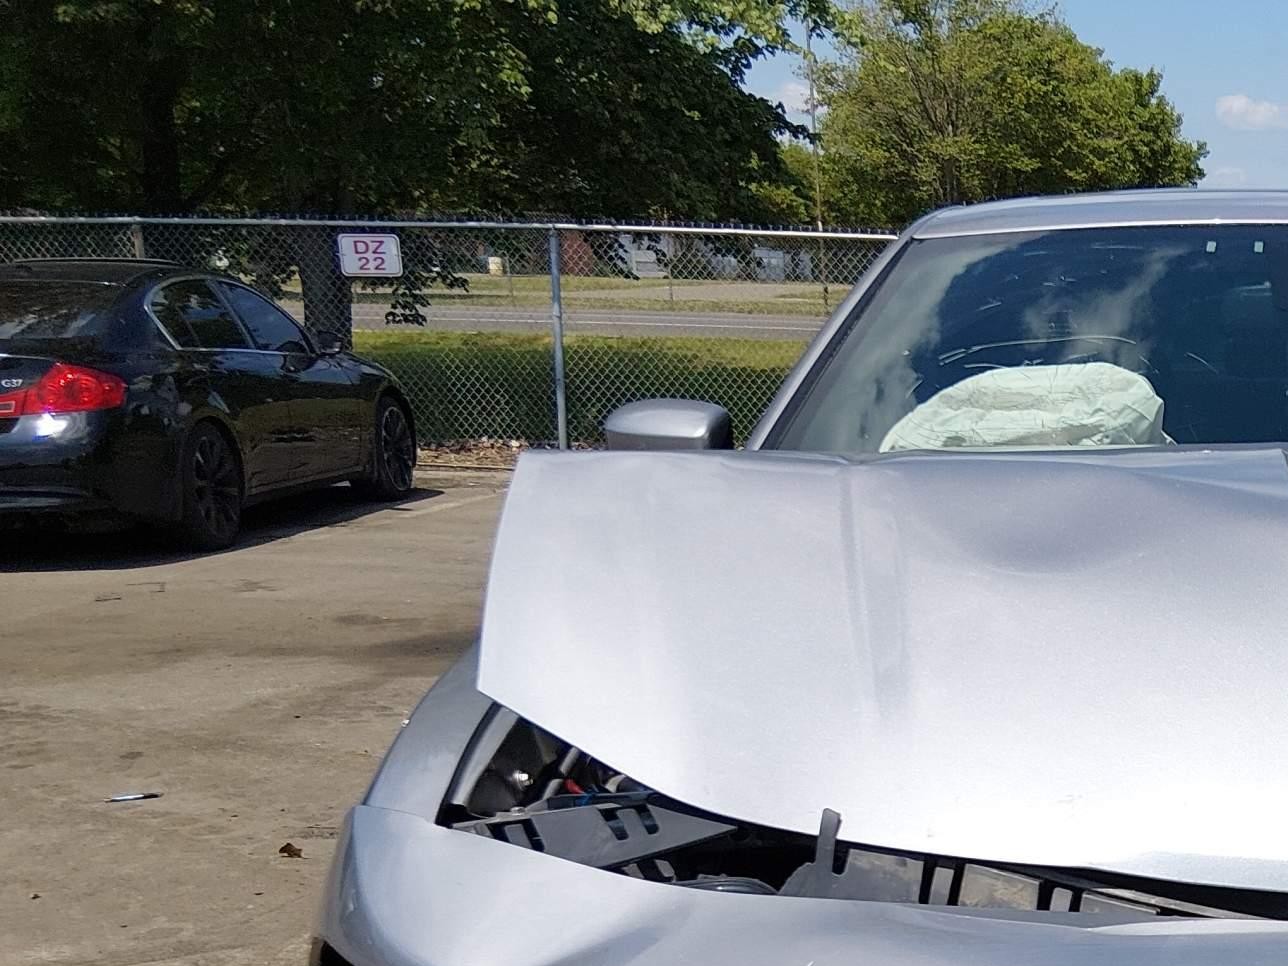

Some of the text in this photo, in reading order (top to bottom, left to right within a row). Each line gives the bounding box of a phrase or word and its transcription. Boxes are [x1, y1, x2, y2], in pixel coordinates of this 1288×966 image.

[353, 240, 386, 255] DZ
[358, 256, 386, 270] 22
[1, 379, 23, 387] G37
